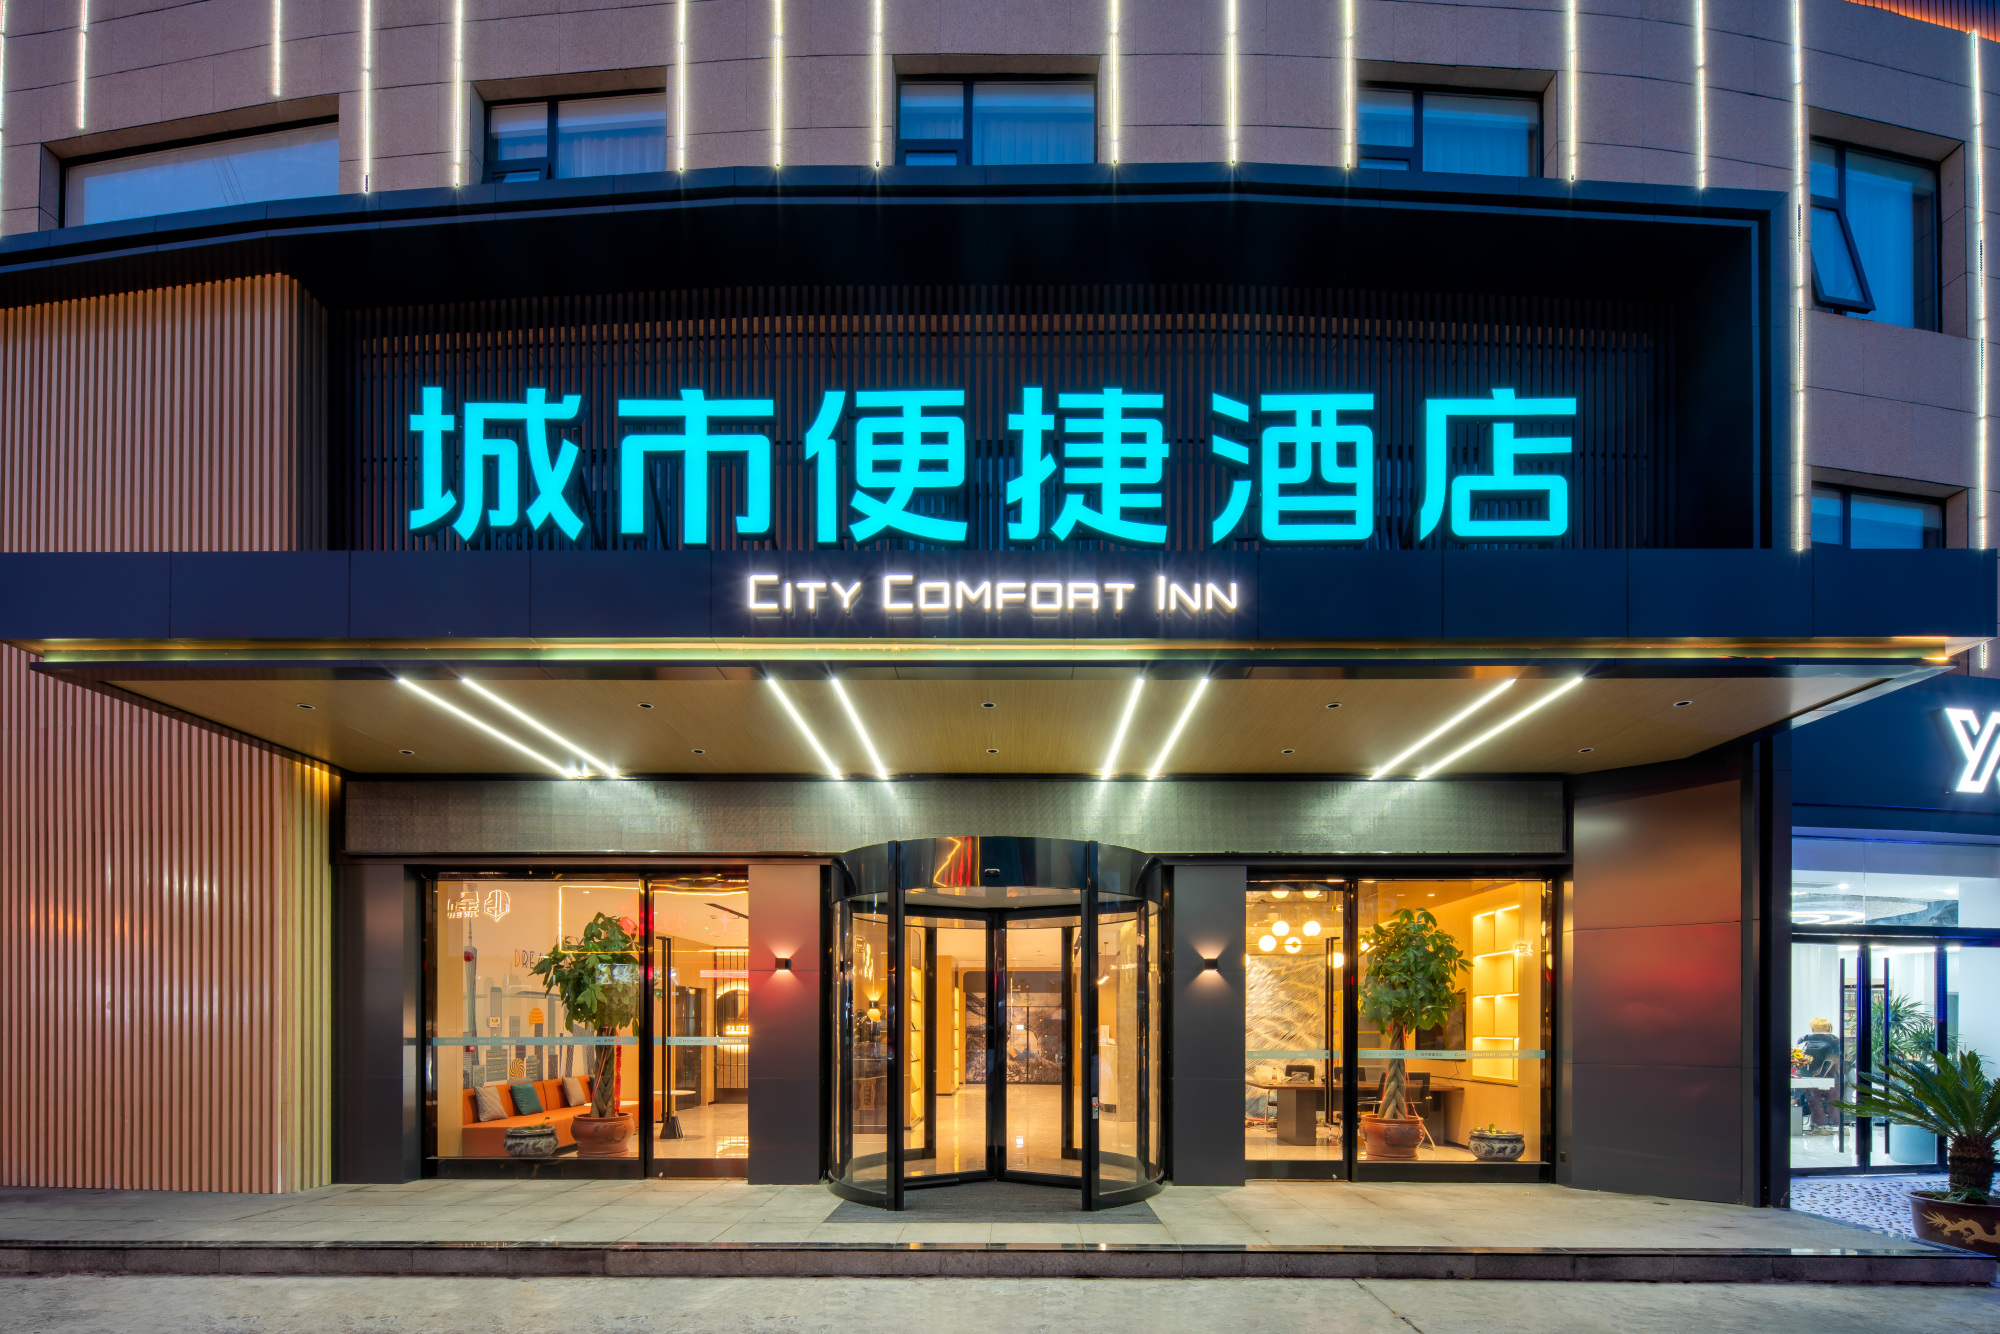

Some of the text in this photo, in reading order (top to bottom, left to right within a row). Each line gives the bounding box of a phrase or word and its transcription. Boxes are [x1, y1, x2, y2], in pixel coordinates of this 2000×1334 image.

[409, 386, 1577, 545] 城市便捷酒店
[749, 574, 1237, 613] CITY COMFORT INN
